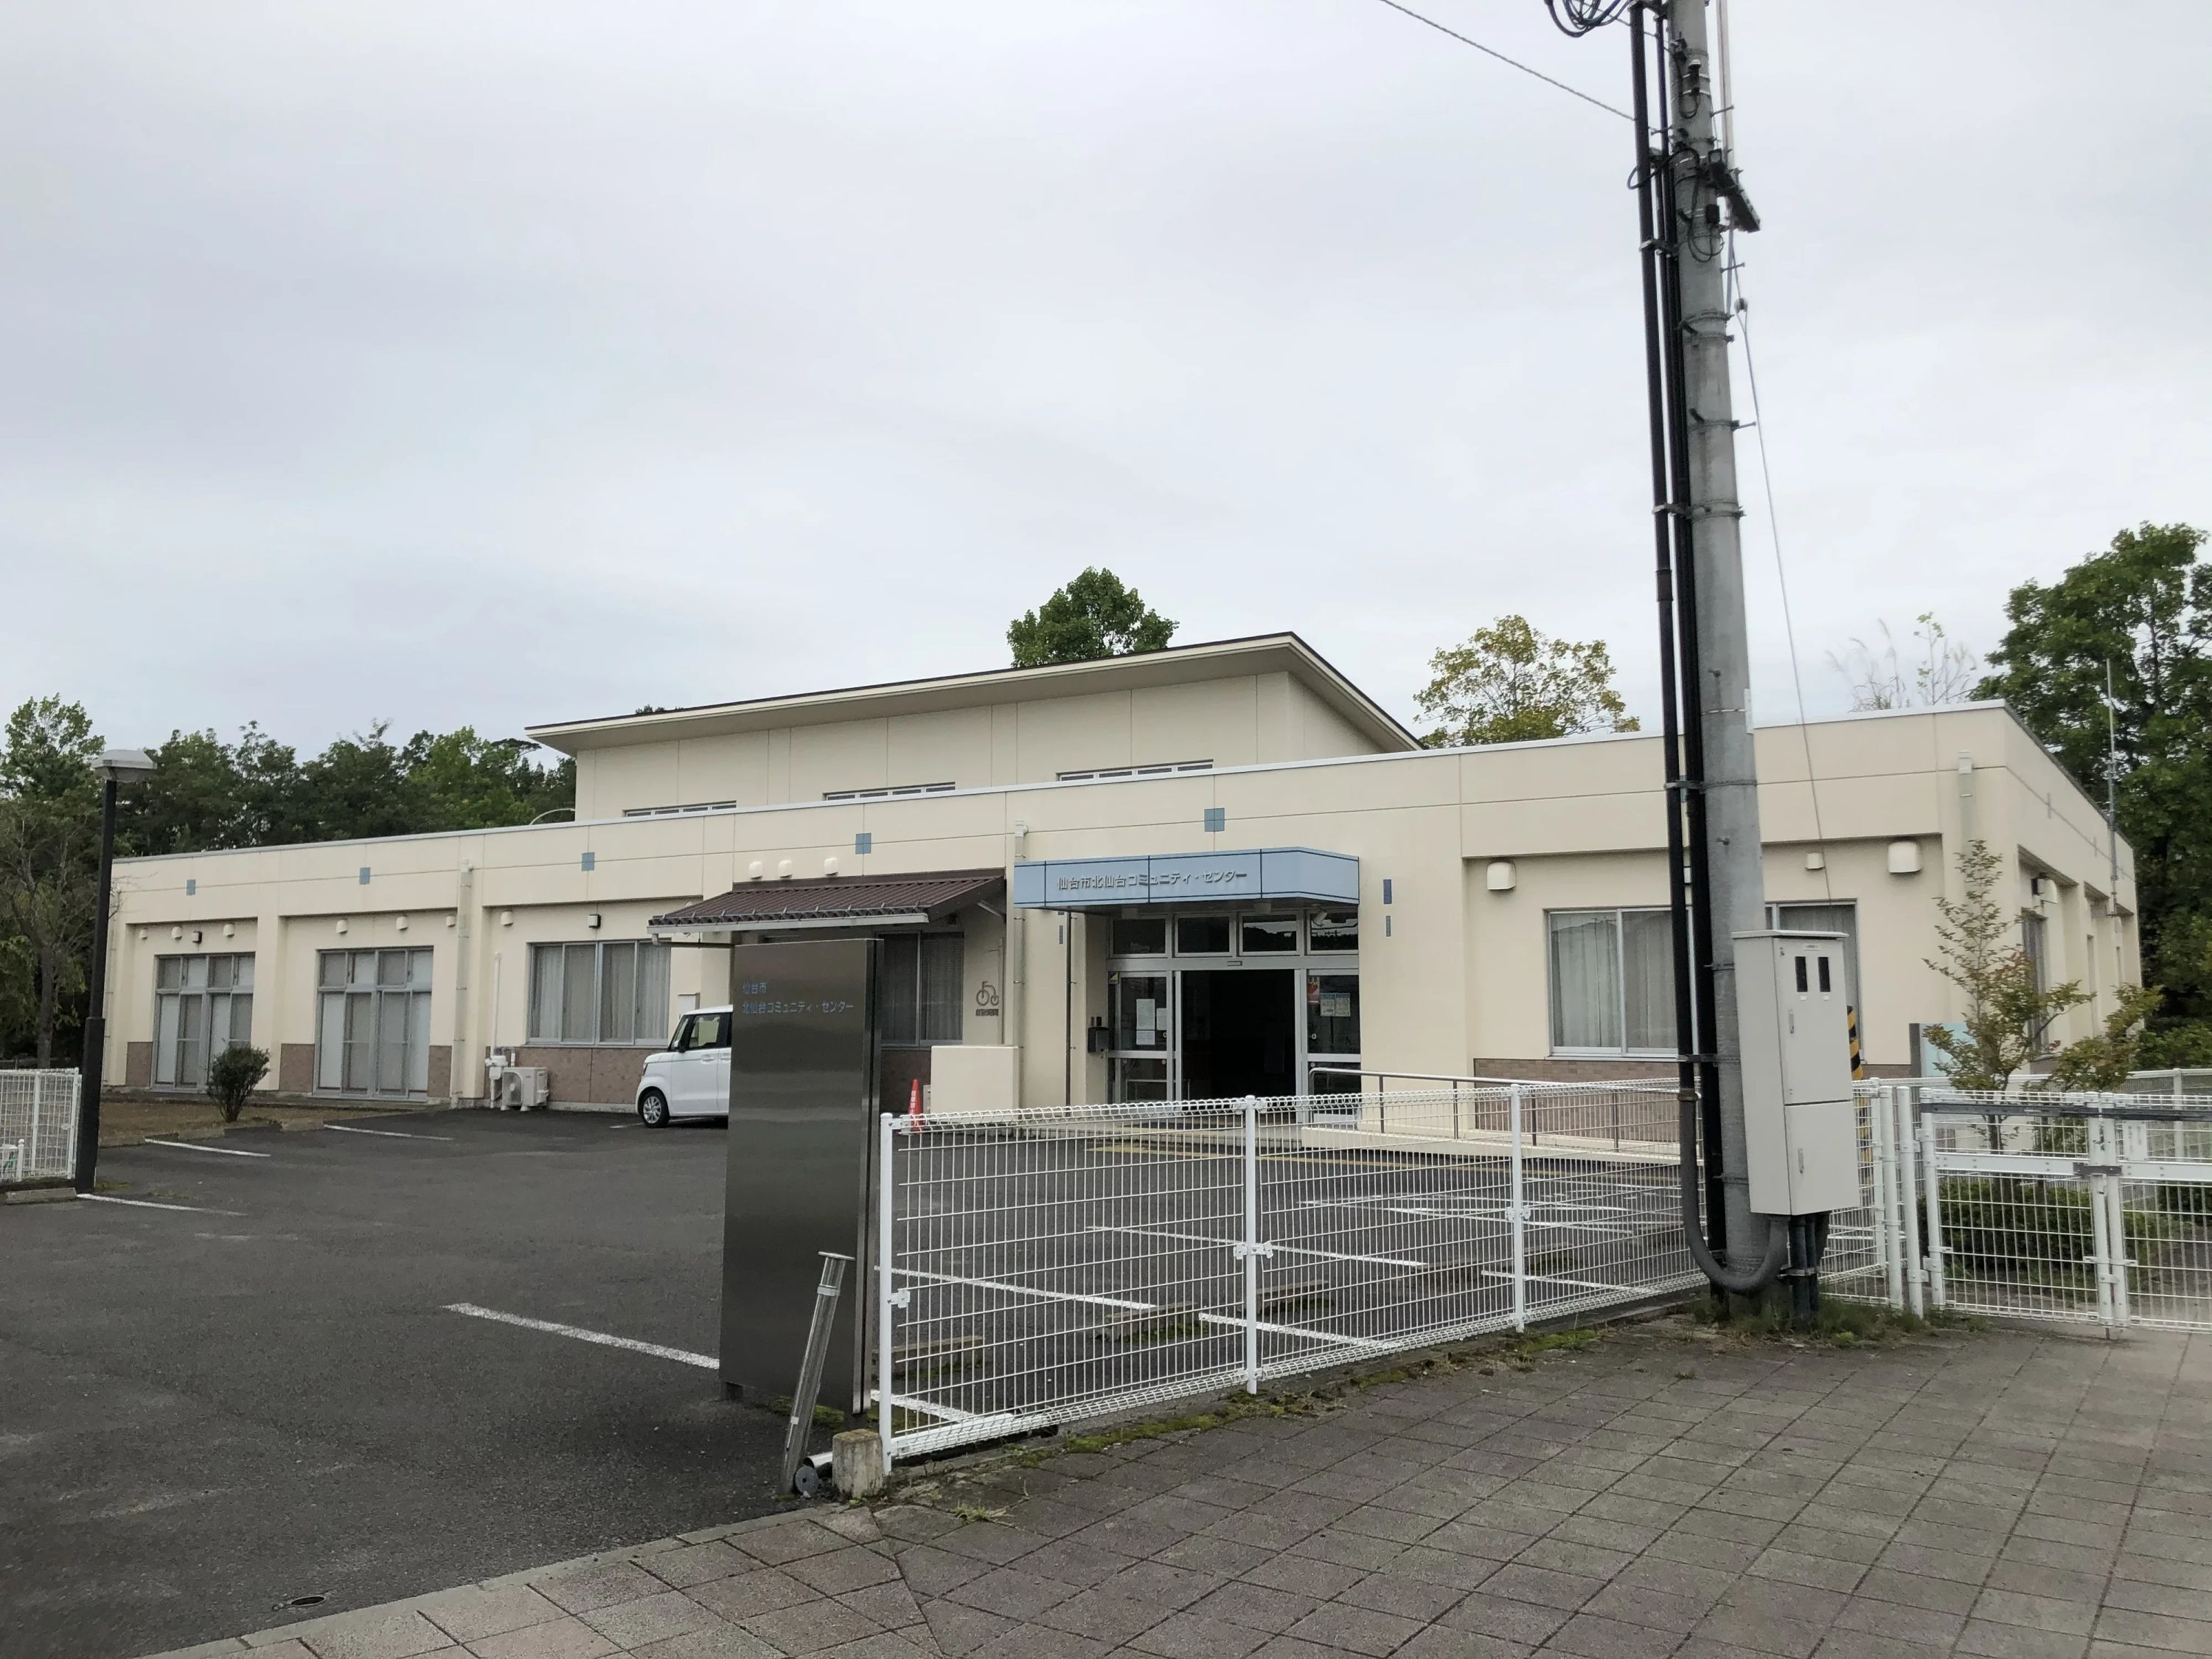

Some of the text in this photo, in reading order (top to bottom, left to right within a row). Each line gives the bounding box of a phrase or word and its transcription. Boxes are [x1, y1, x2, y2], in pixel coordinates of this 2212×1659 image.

[1059, 869, 1247, 890] 仙台市北仙台コミュニティ・センター
